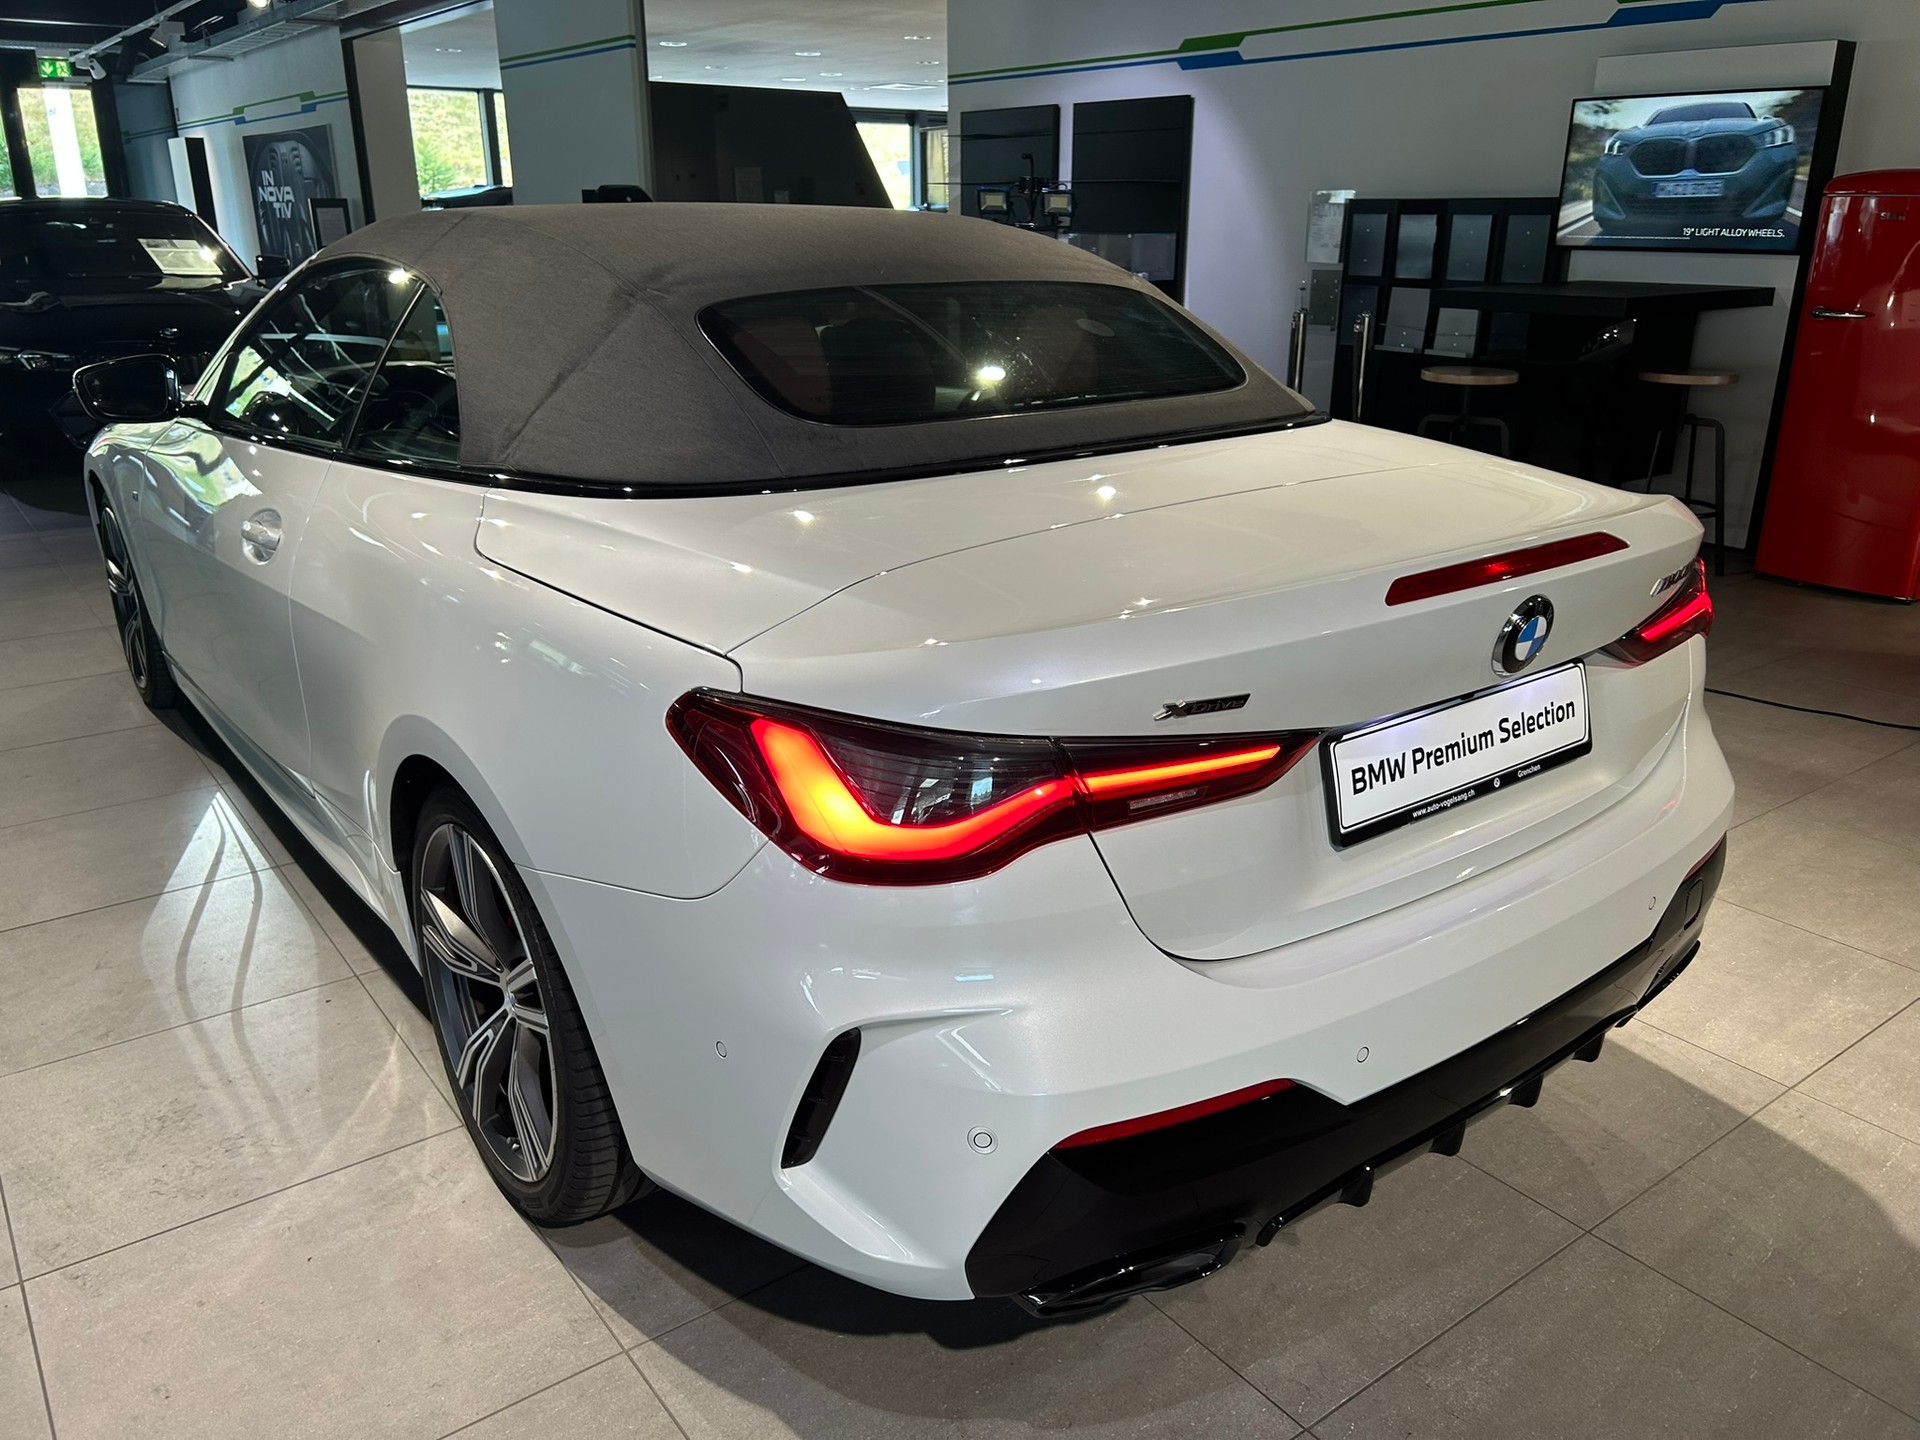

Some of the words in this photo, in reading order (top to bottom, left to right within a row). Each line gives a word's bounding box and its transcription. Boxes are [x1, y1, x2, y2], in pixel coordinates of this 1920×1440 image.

[262, 170, 275, 186] IN
[258, 186, 295, 202] NOVA
[273, 202, 292, 219] TIV
[1695, 222, 1721, 236] LIGHT
[1720, 223, 1748, 237] ALLOY
[1748, 223, 1785, 238] WHEELS.
[1350, 751, 1407, 796] BMW
[1411, 729, 1495, 775] Premium
[1499, 699, 1576, 744] Selection
[1411, 788, 1476, 819] www.auto-vogelsang.ch
[1517, 763, 1542, 779] Grenchen
